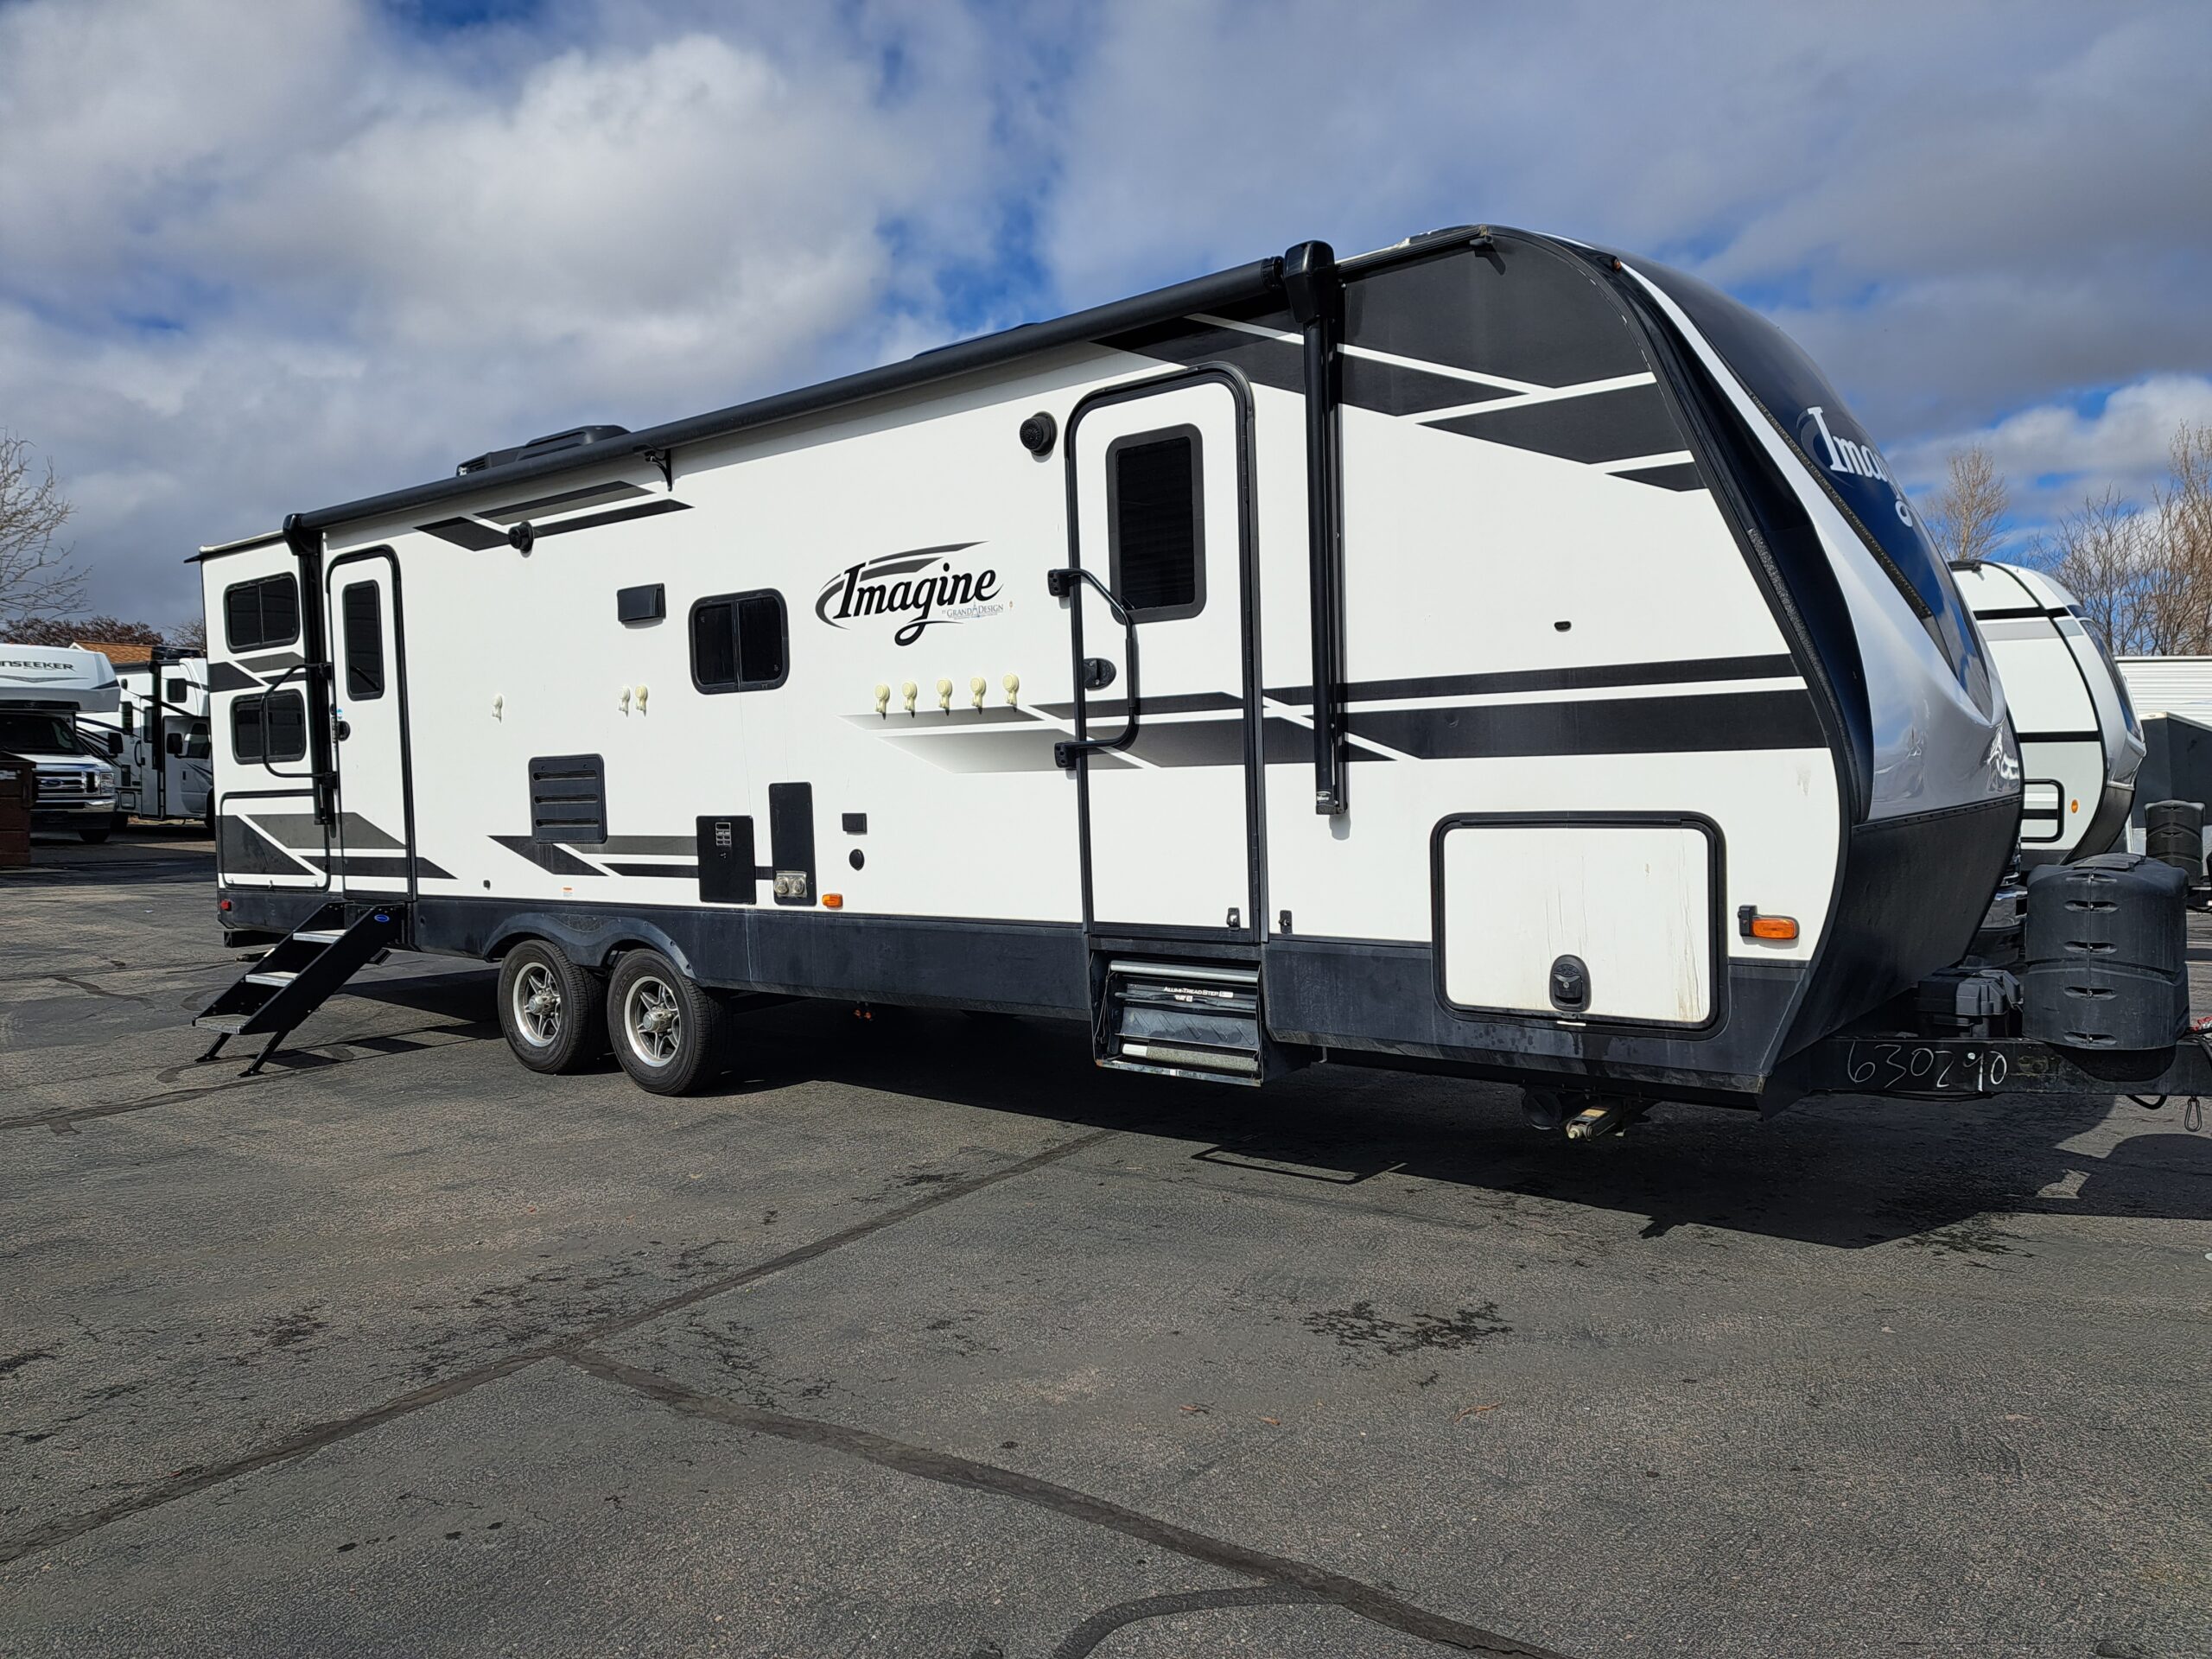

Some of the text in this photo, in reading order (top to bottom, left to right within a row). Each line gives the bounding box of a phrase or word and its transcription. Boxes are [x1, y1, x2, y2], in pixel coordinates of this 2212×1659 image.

[832, 562, 1003, 646] Imagine
[946, 607, 972, 618] GRAND
[977, 604, 1004, 614] DESIGN
[0, 660, 77, 672] NSEEKER
